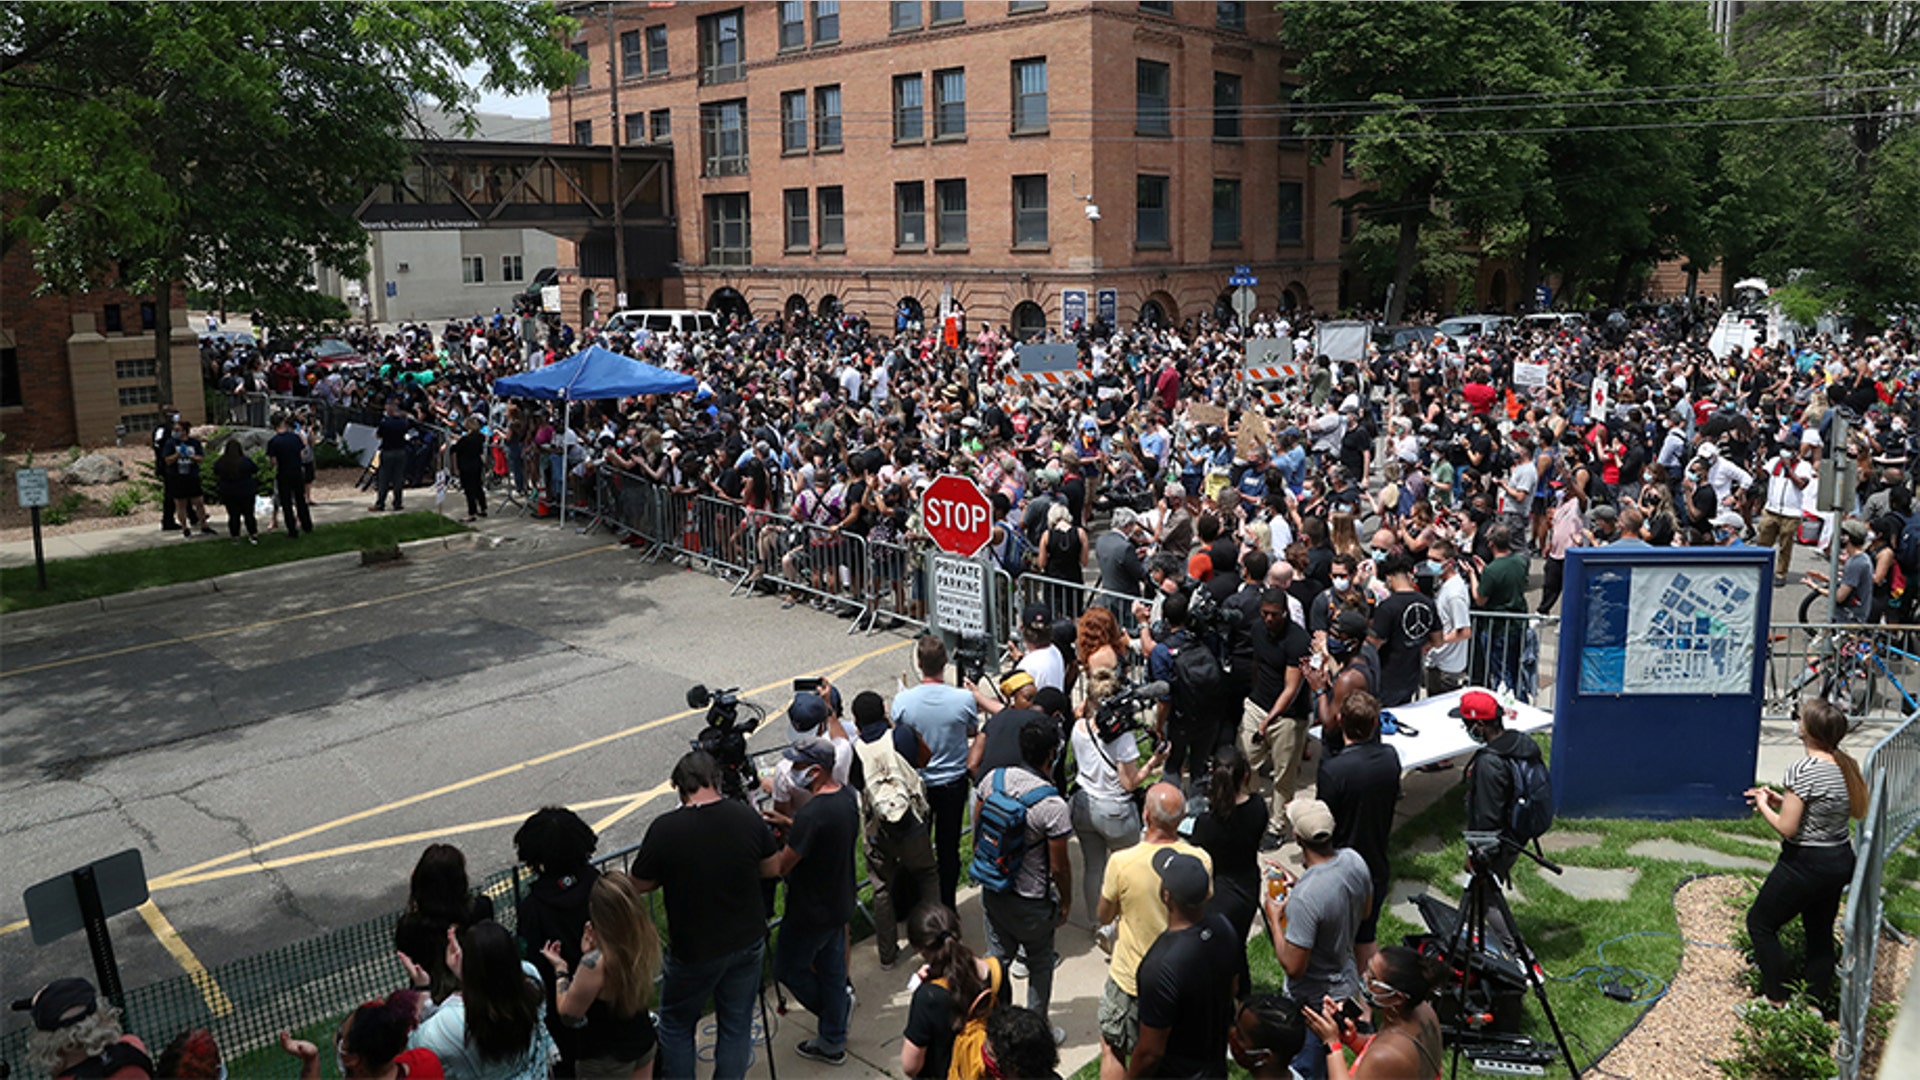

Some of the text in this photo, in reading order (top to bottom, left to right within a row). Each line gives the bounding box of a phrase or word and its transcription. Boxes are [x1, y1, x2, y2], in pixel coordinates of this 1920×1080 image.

[391, 219, 427, 229] Central
[430, 219, 479, 229] University
[927, 497, 986, 533] STOP
[935, 560, 980, 580] PRIVATE
[937, 575, 980, 593] PARKING
[938, 604, 954, 615] CARS
[956, 608, 971, 619] WILL
